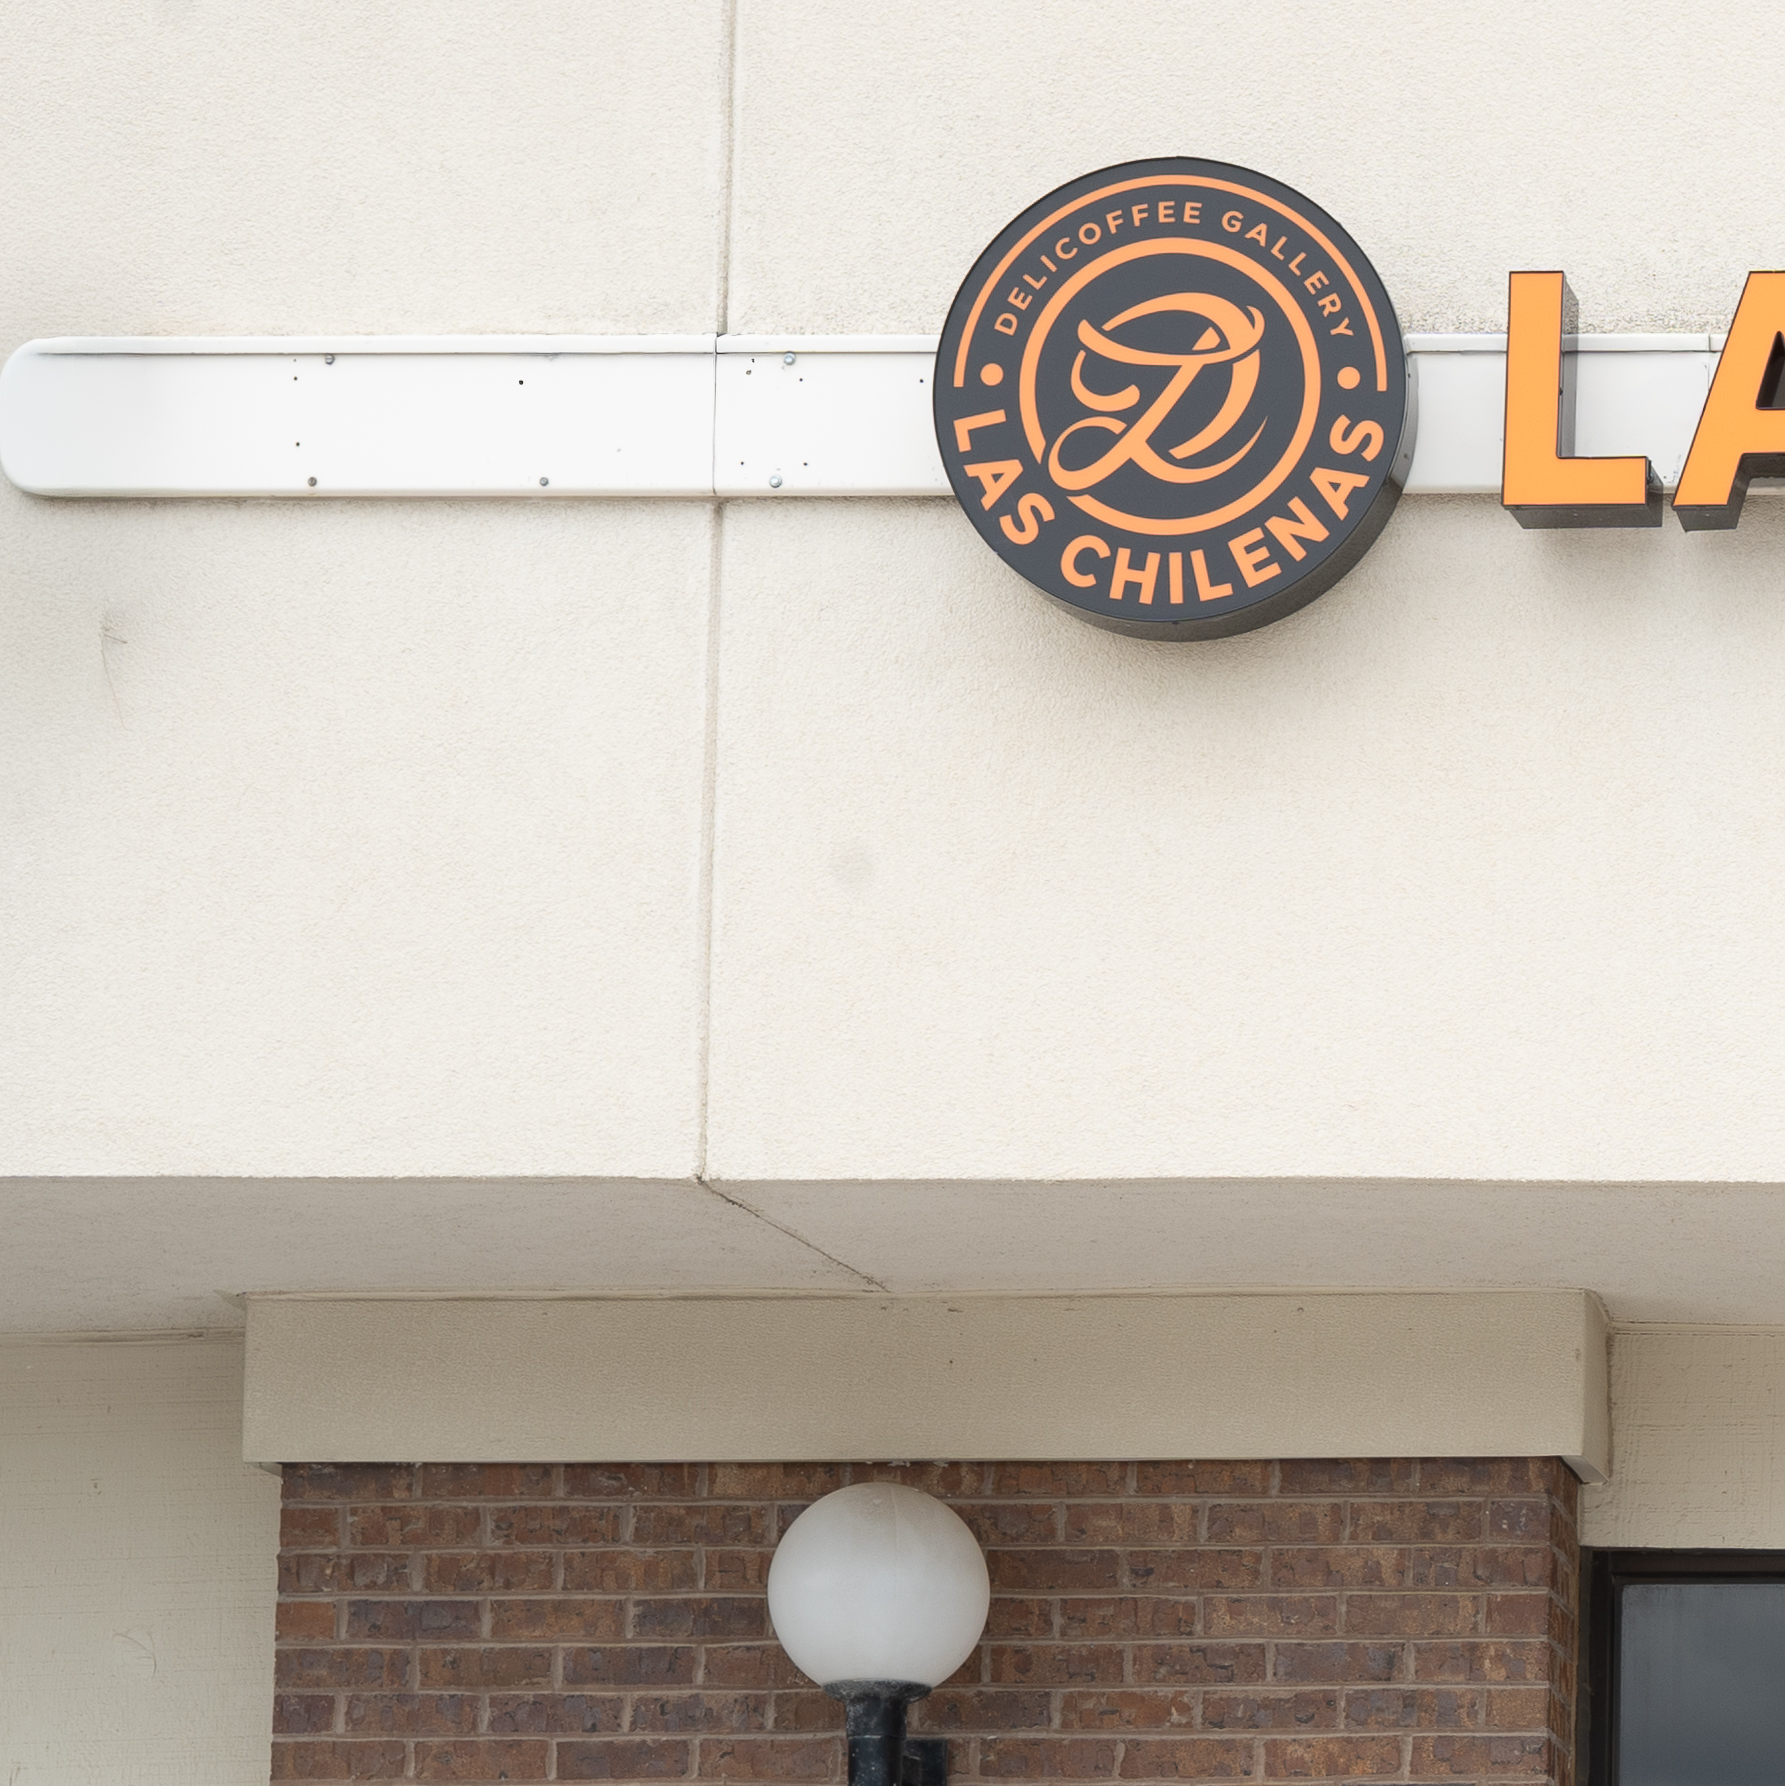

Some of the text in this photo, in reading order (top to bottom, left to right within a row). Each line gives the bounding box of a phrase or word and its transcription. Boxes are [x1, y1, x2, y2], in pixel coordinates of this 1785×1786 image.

[993, 200, 1355, 340] DELICOFFEE GALLERY
[952, 408, 1386, 606] LAS CHILENAS
